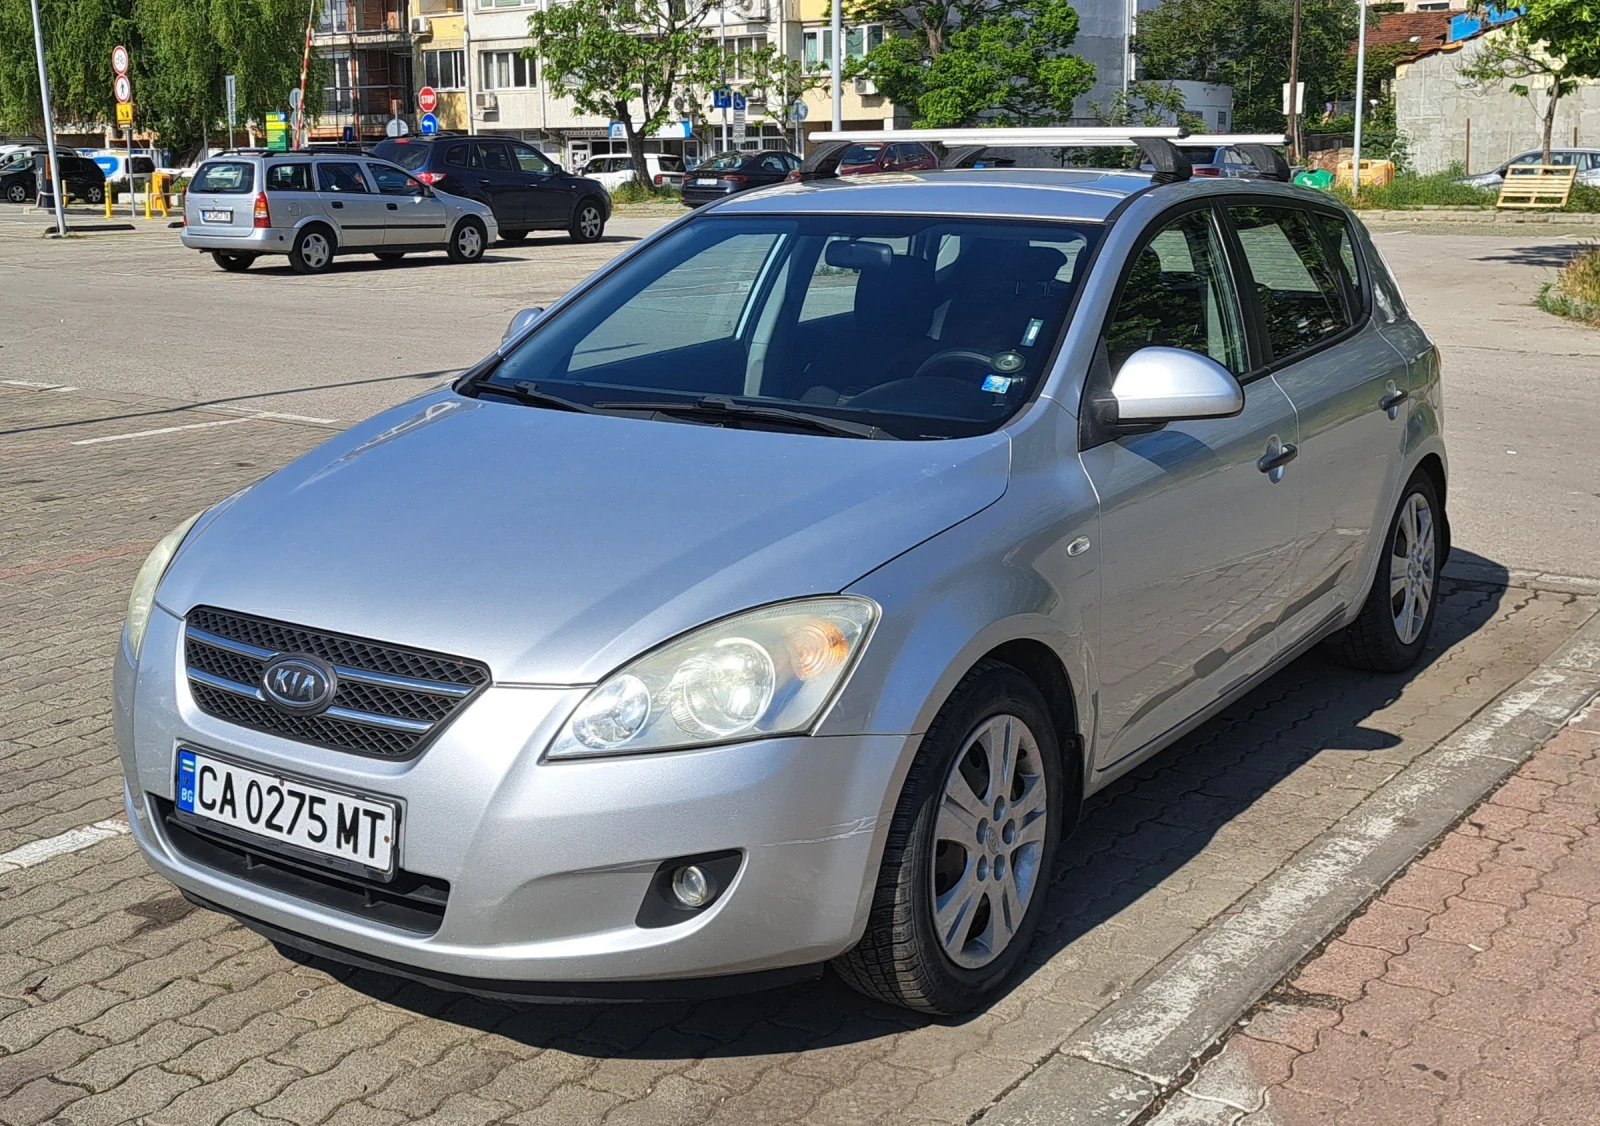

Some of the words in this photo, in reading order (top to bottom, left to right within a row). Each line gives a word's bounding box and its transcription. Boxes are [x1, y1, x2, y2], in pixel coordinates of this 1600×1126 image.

[421, 95, 434, 104] STOP
[273, 667, 315, 701] KIA
[181, 787, 194, 803] BG
[198, 765, 237, 819] CA
[245, 779, 328, 844] 0275
[336, 802, 386, 859] MT
